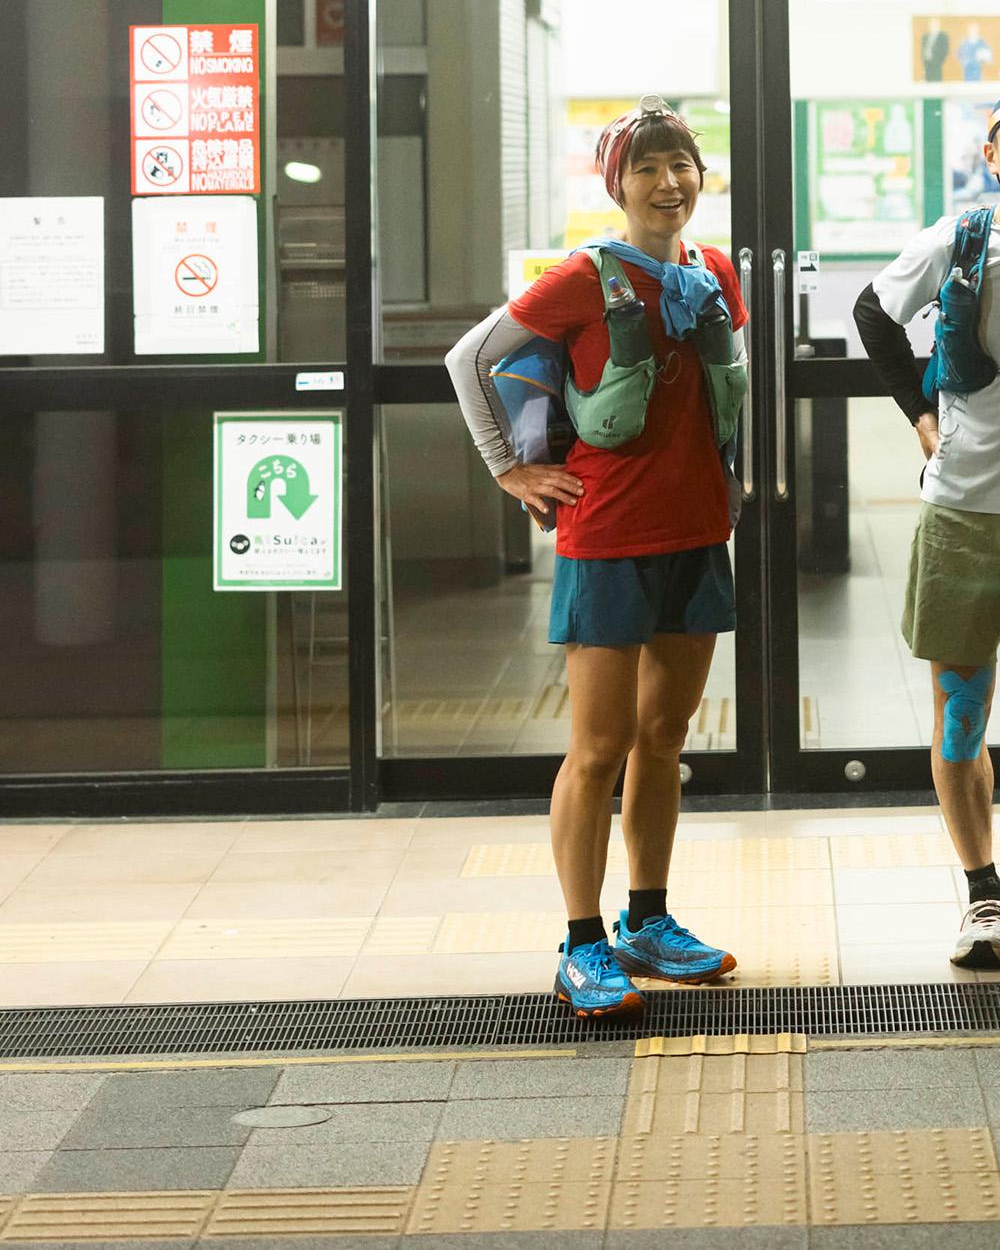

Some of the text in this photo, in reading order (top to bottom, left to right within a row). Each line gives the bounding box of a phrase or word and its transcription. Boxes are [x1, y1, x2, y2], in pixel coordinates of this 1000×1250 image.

[207, 57, 254, 74] SMOKING
[236, 433, 322, 446] タクシー乗り場
[258, 459, 298, 479] こちら
